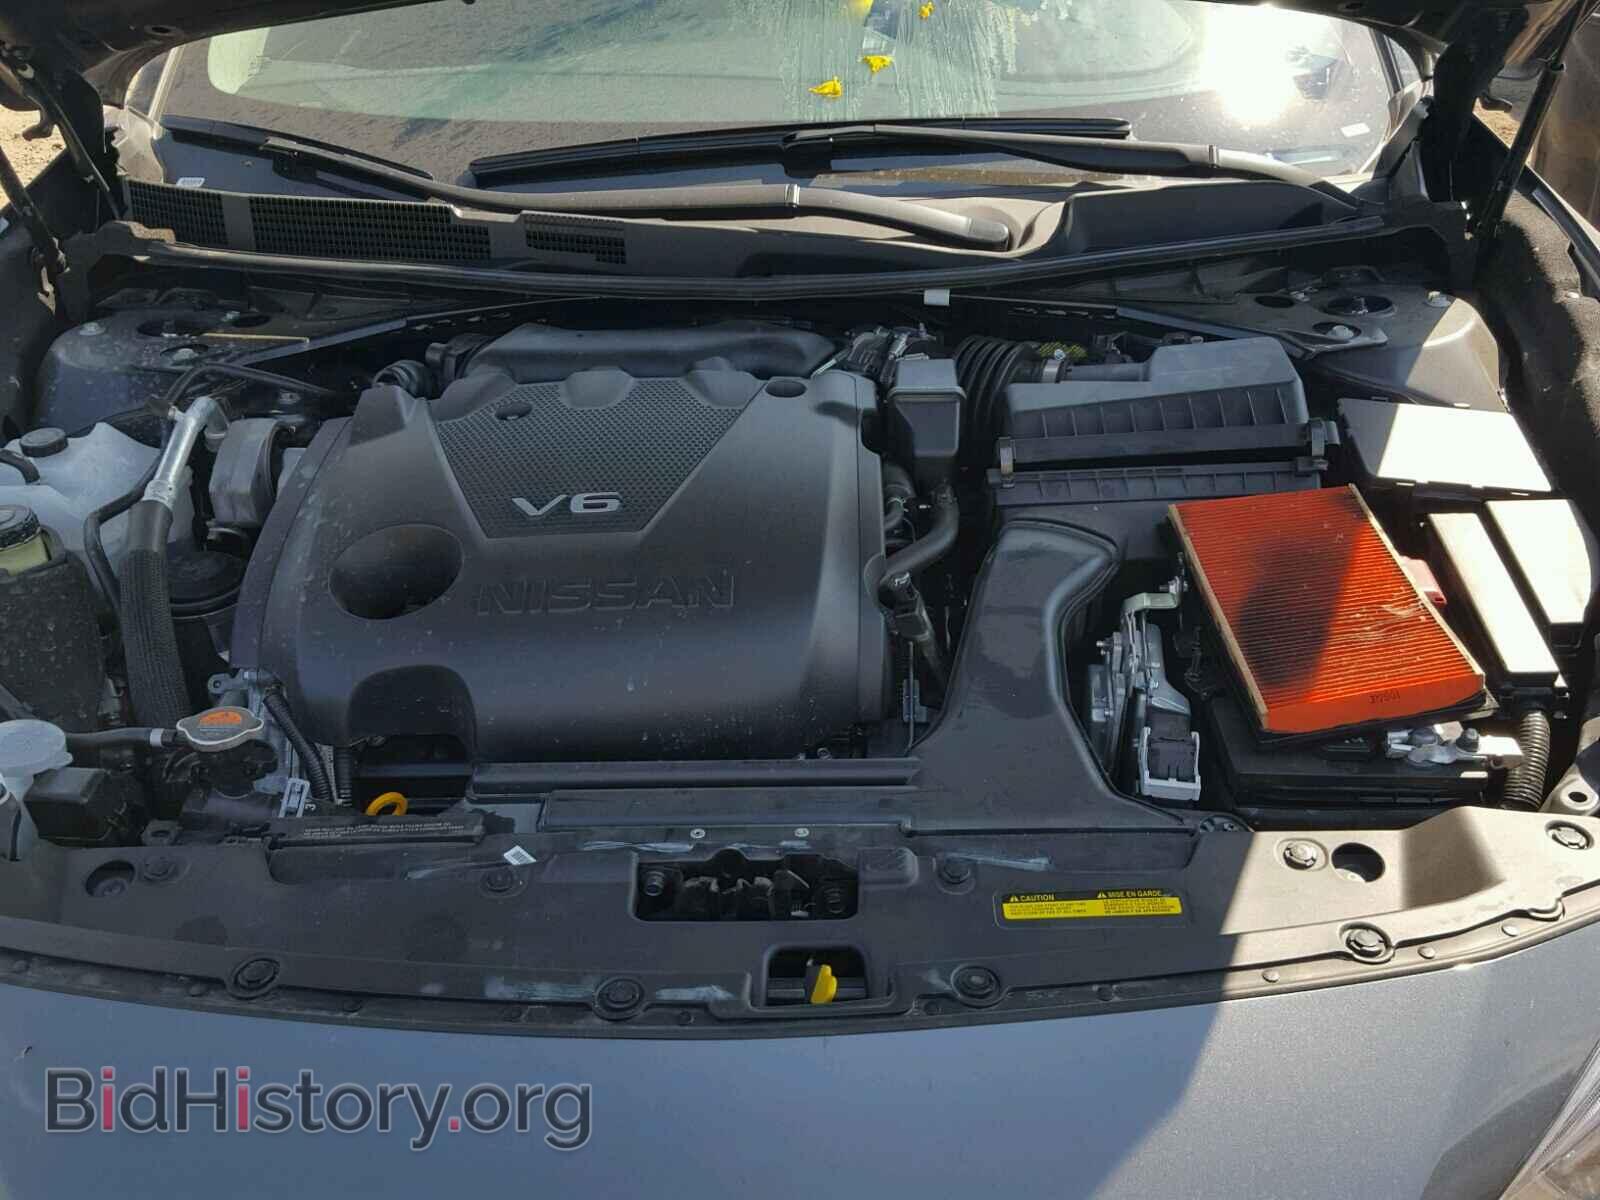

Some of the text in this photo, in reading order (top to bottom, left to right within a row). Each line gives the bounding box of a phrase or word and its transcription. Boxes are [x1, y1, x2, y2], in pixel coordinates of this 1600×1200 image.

[512, 491, 622, 517] V6
[476, 573, 736, 617] NISSAN
[1020, 894, 1055, 902] CAUTION
